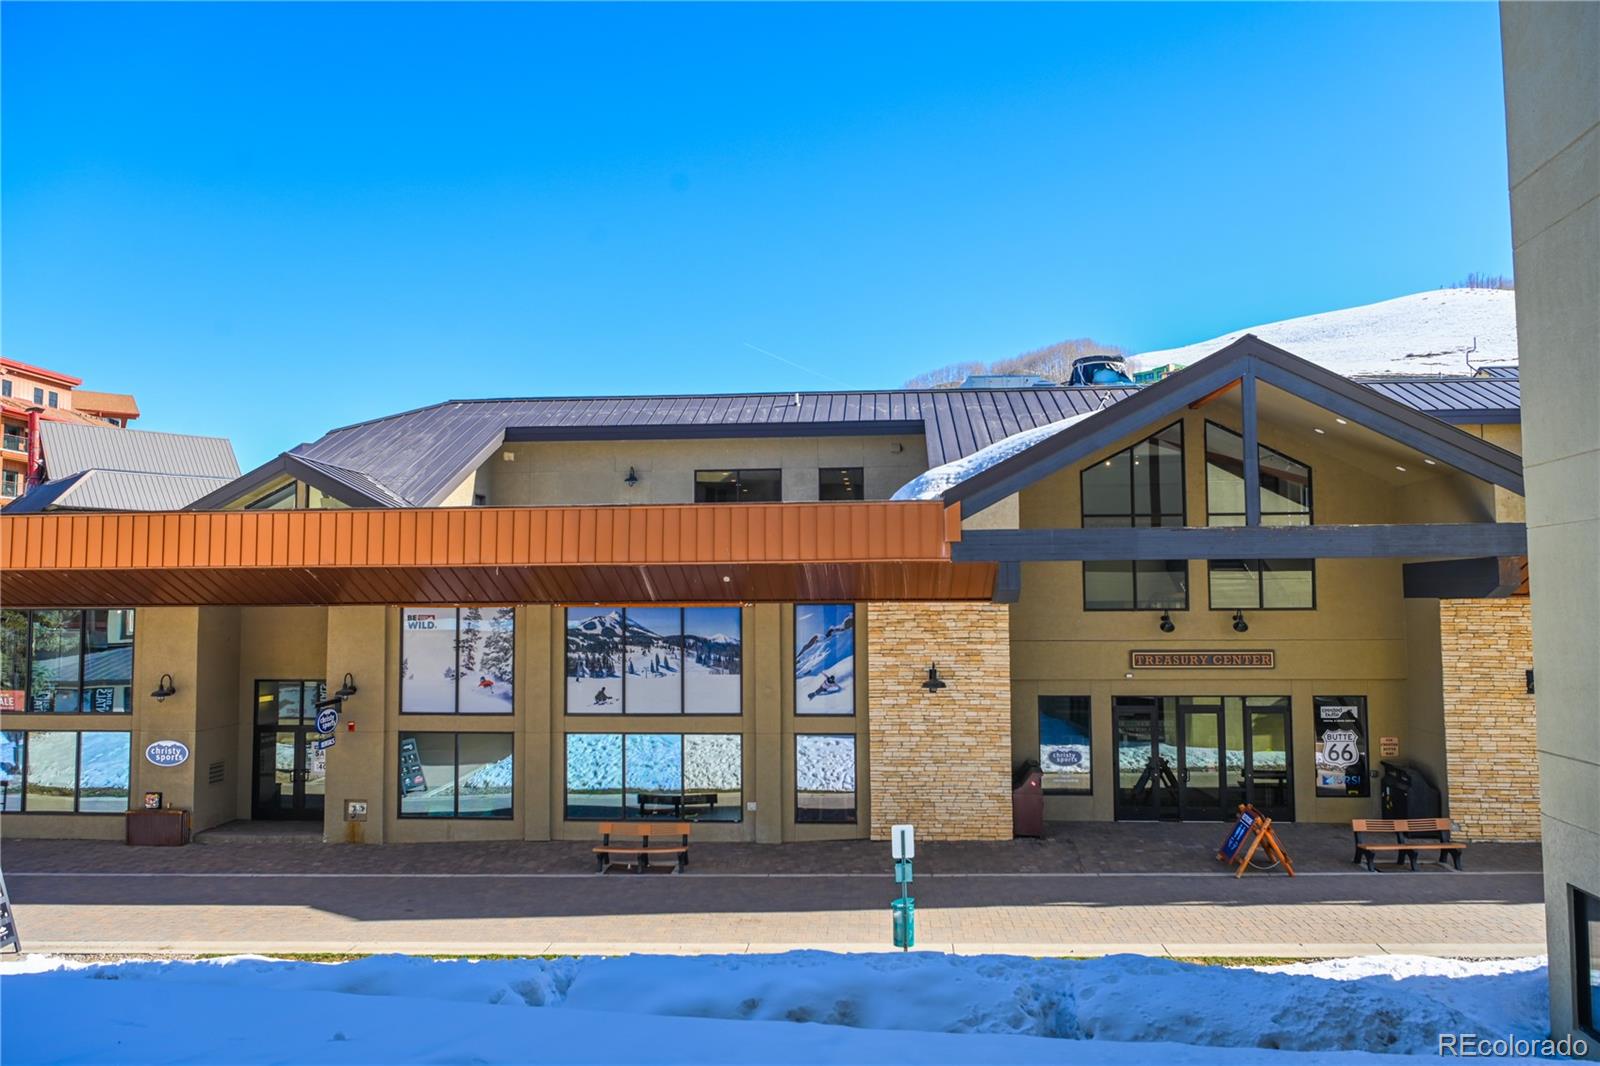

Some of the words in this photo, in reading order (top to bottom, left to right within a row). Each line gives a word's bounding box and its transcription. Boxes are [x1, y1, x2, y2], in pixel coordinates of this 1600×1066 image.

[408, 621, 437, 629] WILD.
[1135, 655, 1208, 665] TREASURY
[1212, 655, 1271, 665] CENTER
[1326, 733, 1353, 741] BUTTE
[150, 746, 182, 756] christy
[1328, 743, 1353, 761] 66
[155, 754, 184, 762] sports
